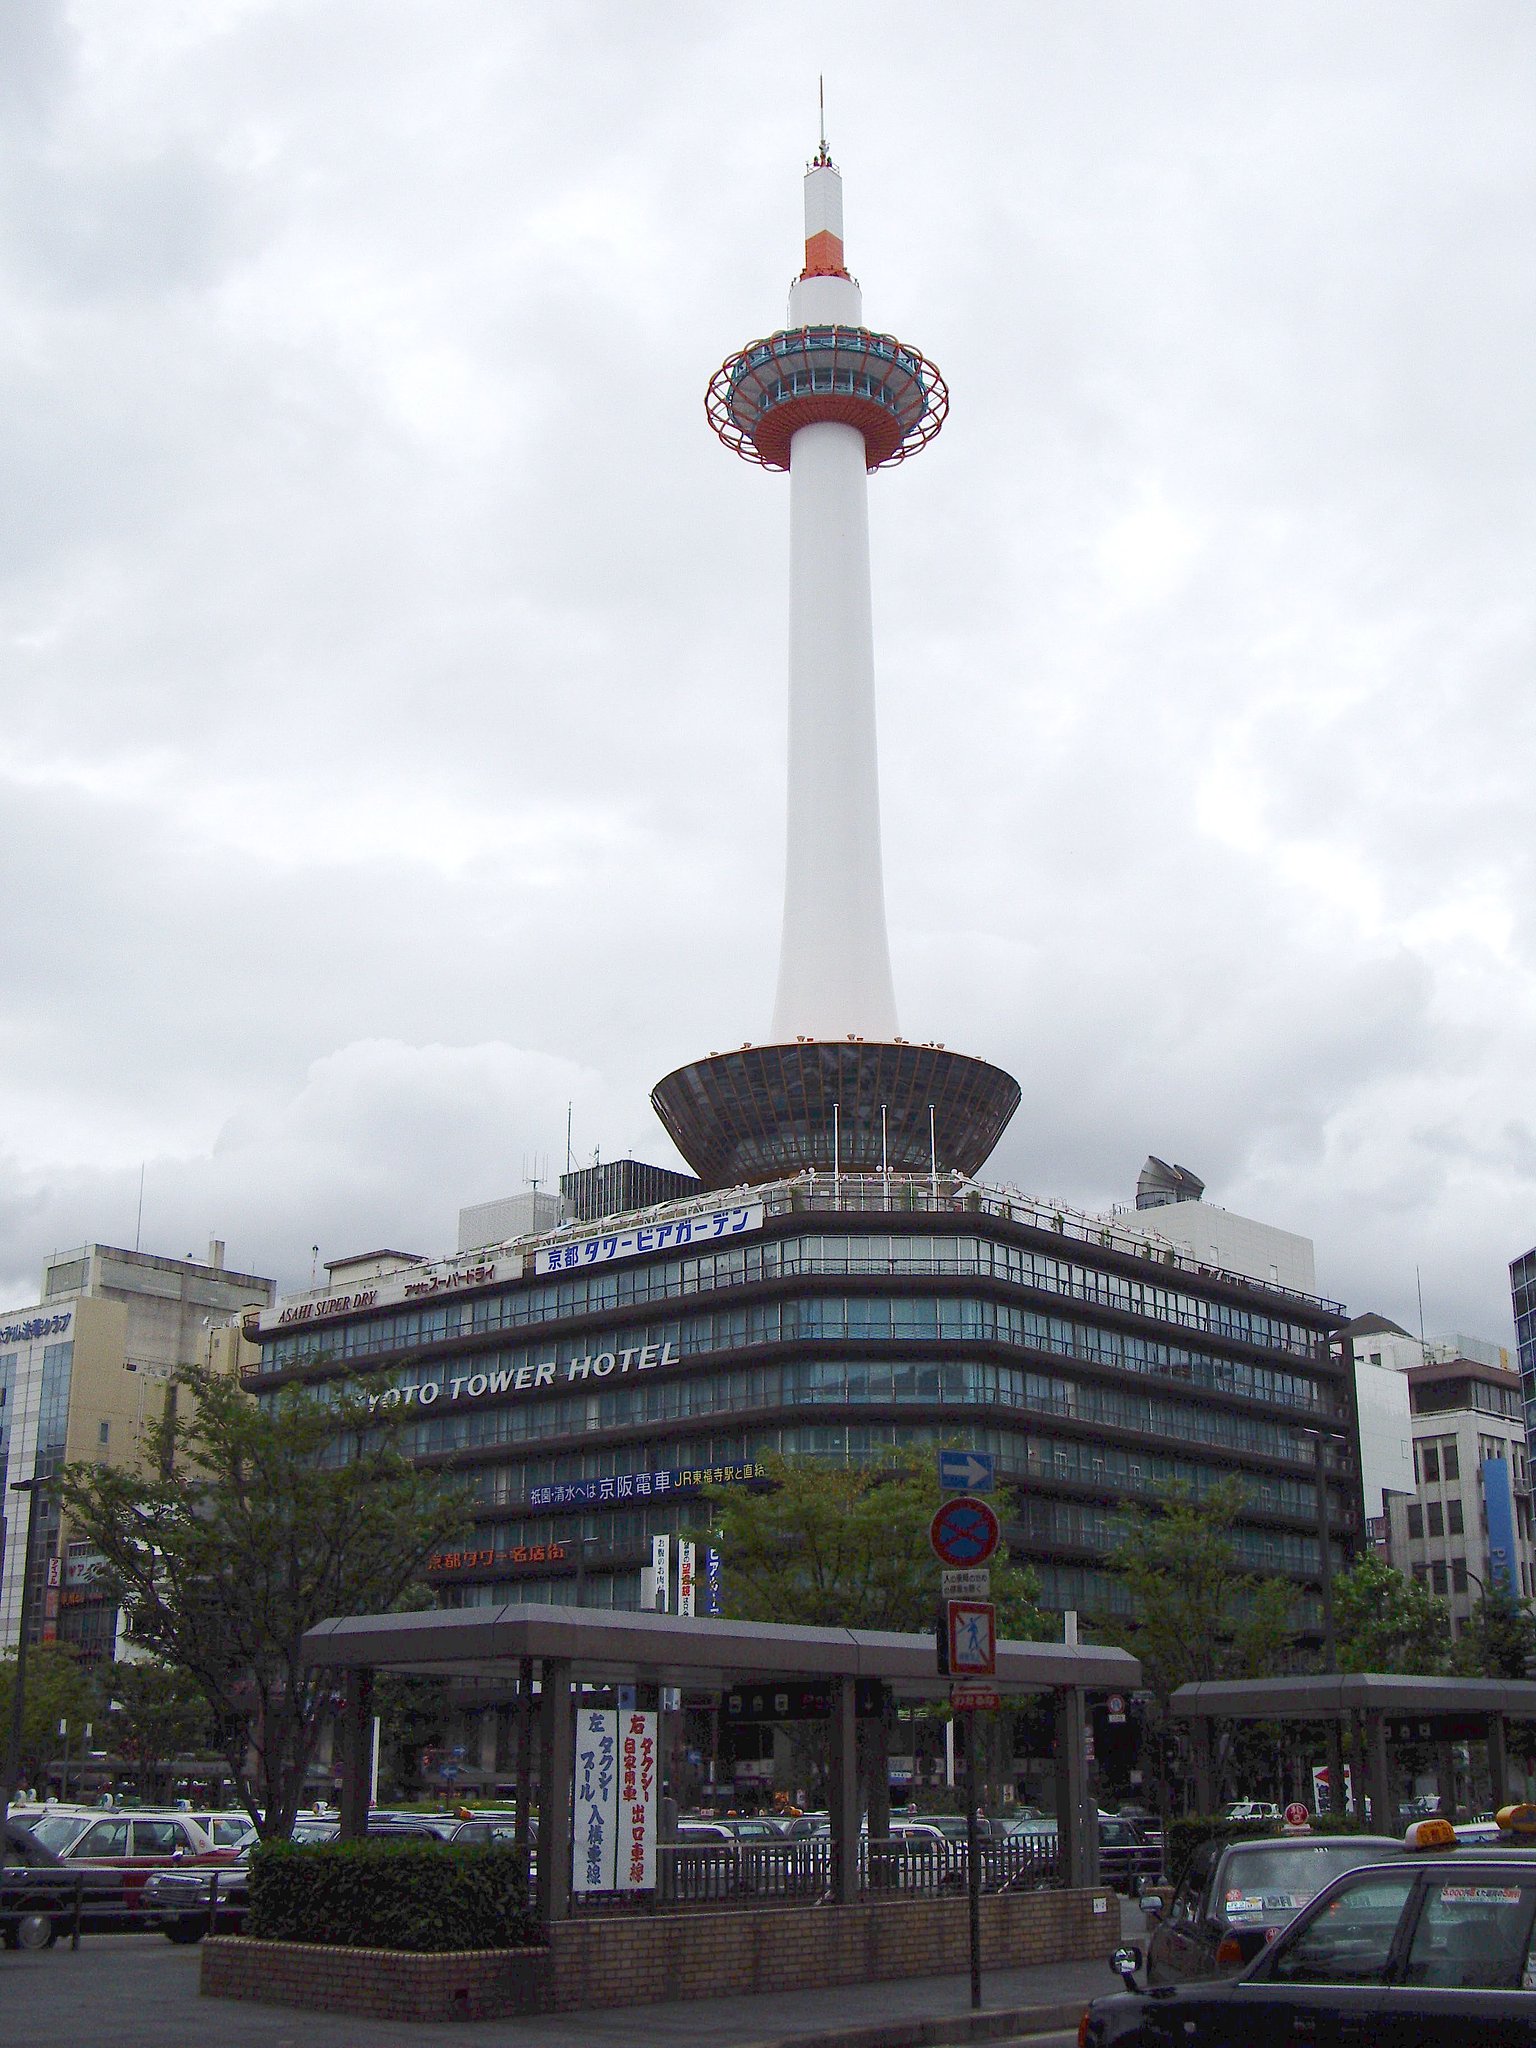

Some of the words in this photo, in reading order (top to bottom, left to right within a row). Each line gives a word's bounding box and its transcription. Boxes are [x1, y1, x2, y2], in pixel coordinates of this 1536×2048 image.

[403, 1264, 496, 1297] アサヒスーパードライ
[278, 1304, 313, 1324] ASAHI
[314, 1297, 351, 1317] SUPER
[352, 1290, 378, 1309] DRY
[450, 1362, 556, 1400] TOWER
[567, 1342, 681, 1381] HOTEL
[599, 1470, 672, 1500] 京阪電車
[427, 1543, 567, 1571] 京都タワー名店街
[588, 1712, 605, 1733] 左
[629, 1714, 646, 1735] 右
[598, 1736, 614, 1802] タクシー
[622, 1737, 637, 1802] 自家用車
[640, 1737, 654, 1803] タクシー
[586, 1804, 605, 1885] 入構車線
[629, 1804, 646, 1884] 出口車線
